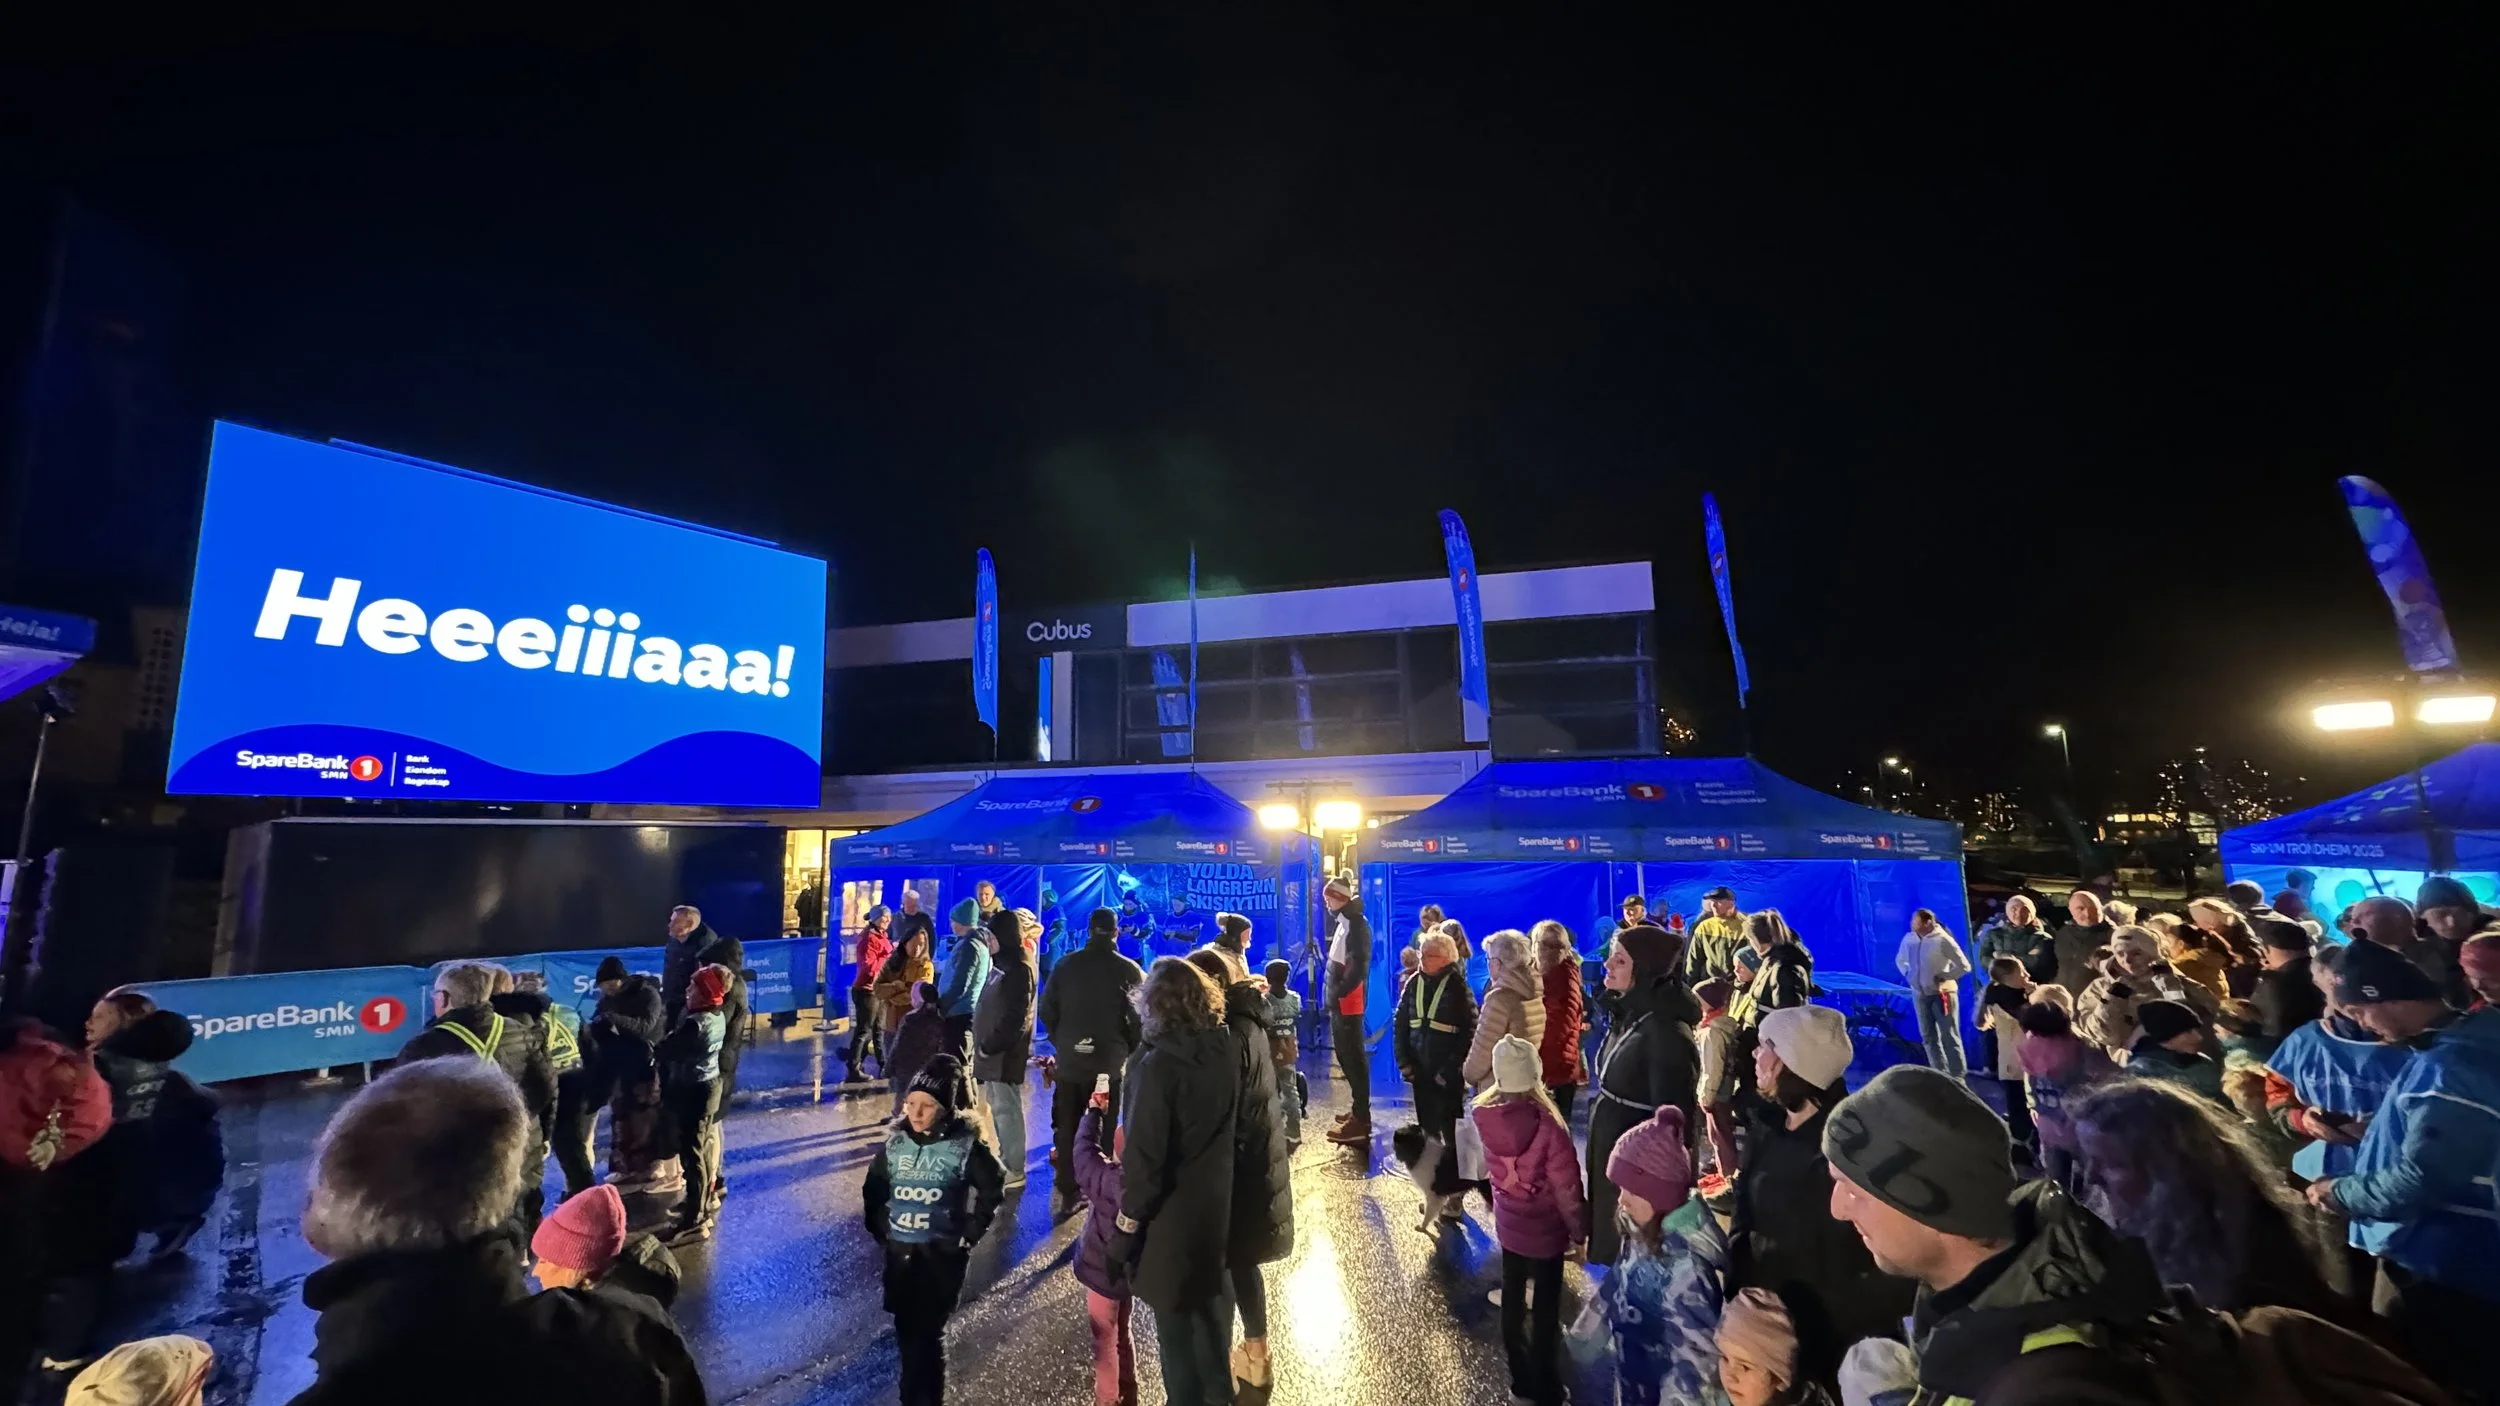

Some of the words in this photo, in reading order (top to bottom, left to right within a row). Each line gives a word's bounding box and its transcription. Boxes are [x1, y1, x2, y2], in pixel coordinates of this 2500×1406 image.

[254, 568, 795, 698] Heeeiiiaaa!
[1026, 618, 1092, 642] Cubus
[236, 750, 349, 770] SpareBank
[406, 754, 429, 764] Bank
[320, 770, 348, 780] SMN
[405, 765, 447, 775] Eiendom
[404, 777, 450, 787] Regnskap
[1500, 784, 1623, 798] SpareBank
[975, 797, 1073, 811] SpareBank
[1381, 840, 1424, 849] SpareBank
[1518, 837, 1565, 847] SpareBank
[1665, 836, 1714, 847] SpareBank
[1820, 834, 1873, 844] SpareBank
[1188, 863, 1254, 880] VOLDA
[1187, 878, 1277, 895] LANGRENN
[315, 1025, 355, 1038] SMN
[894, 1186, 943, 1205] coop
